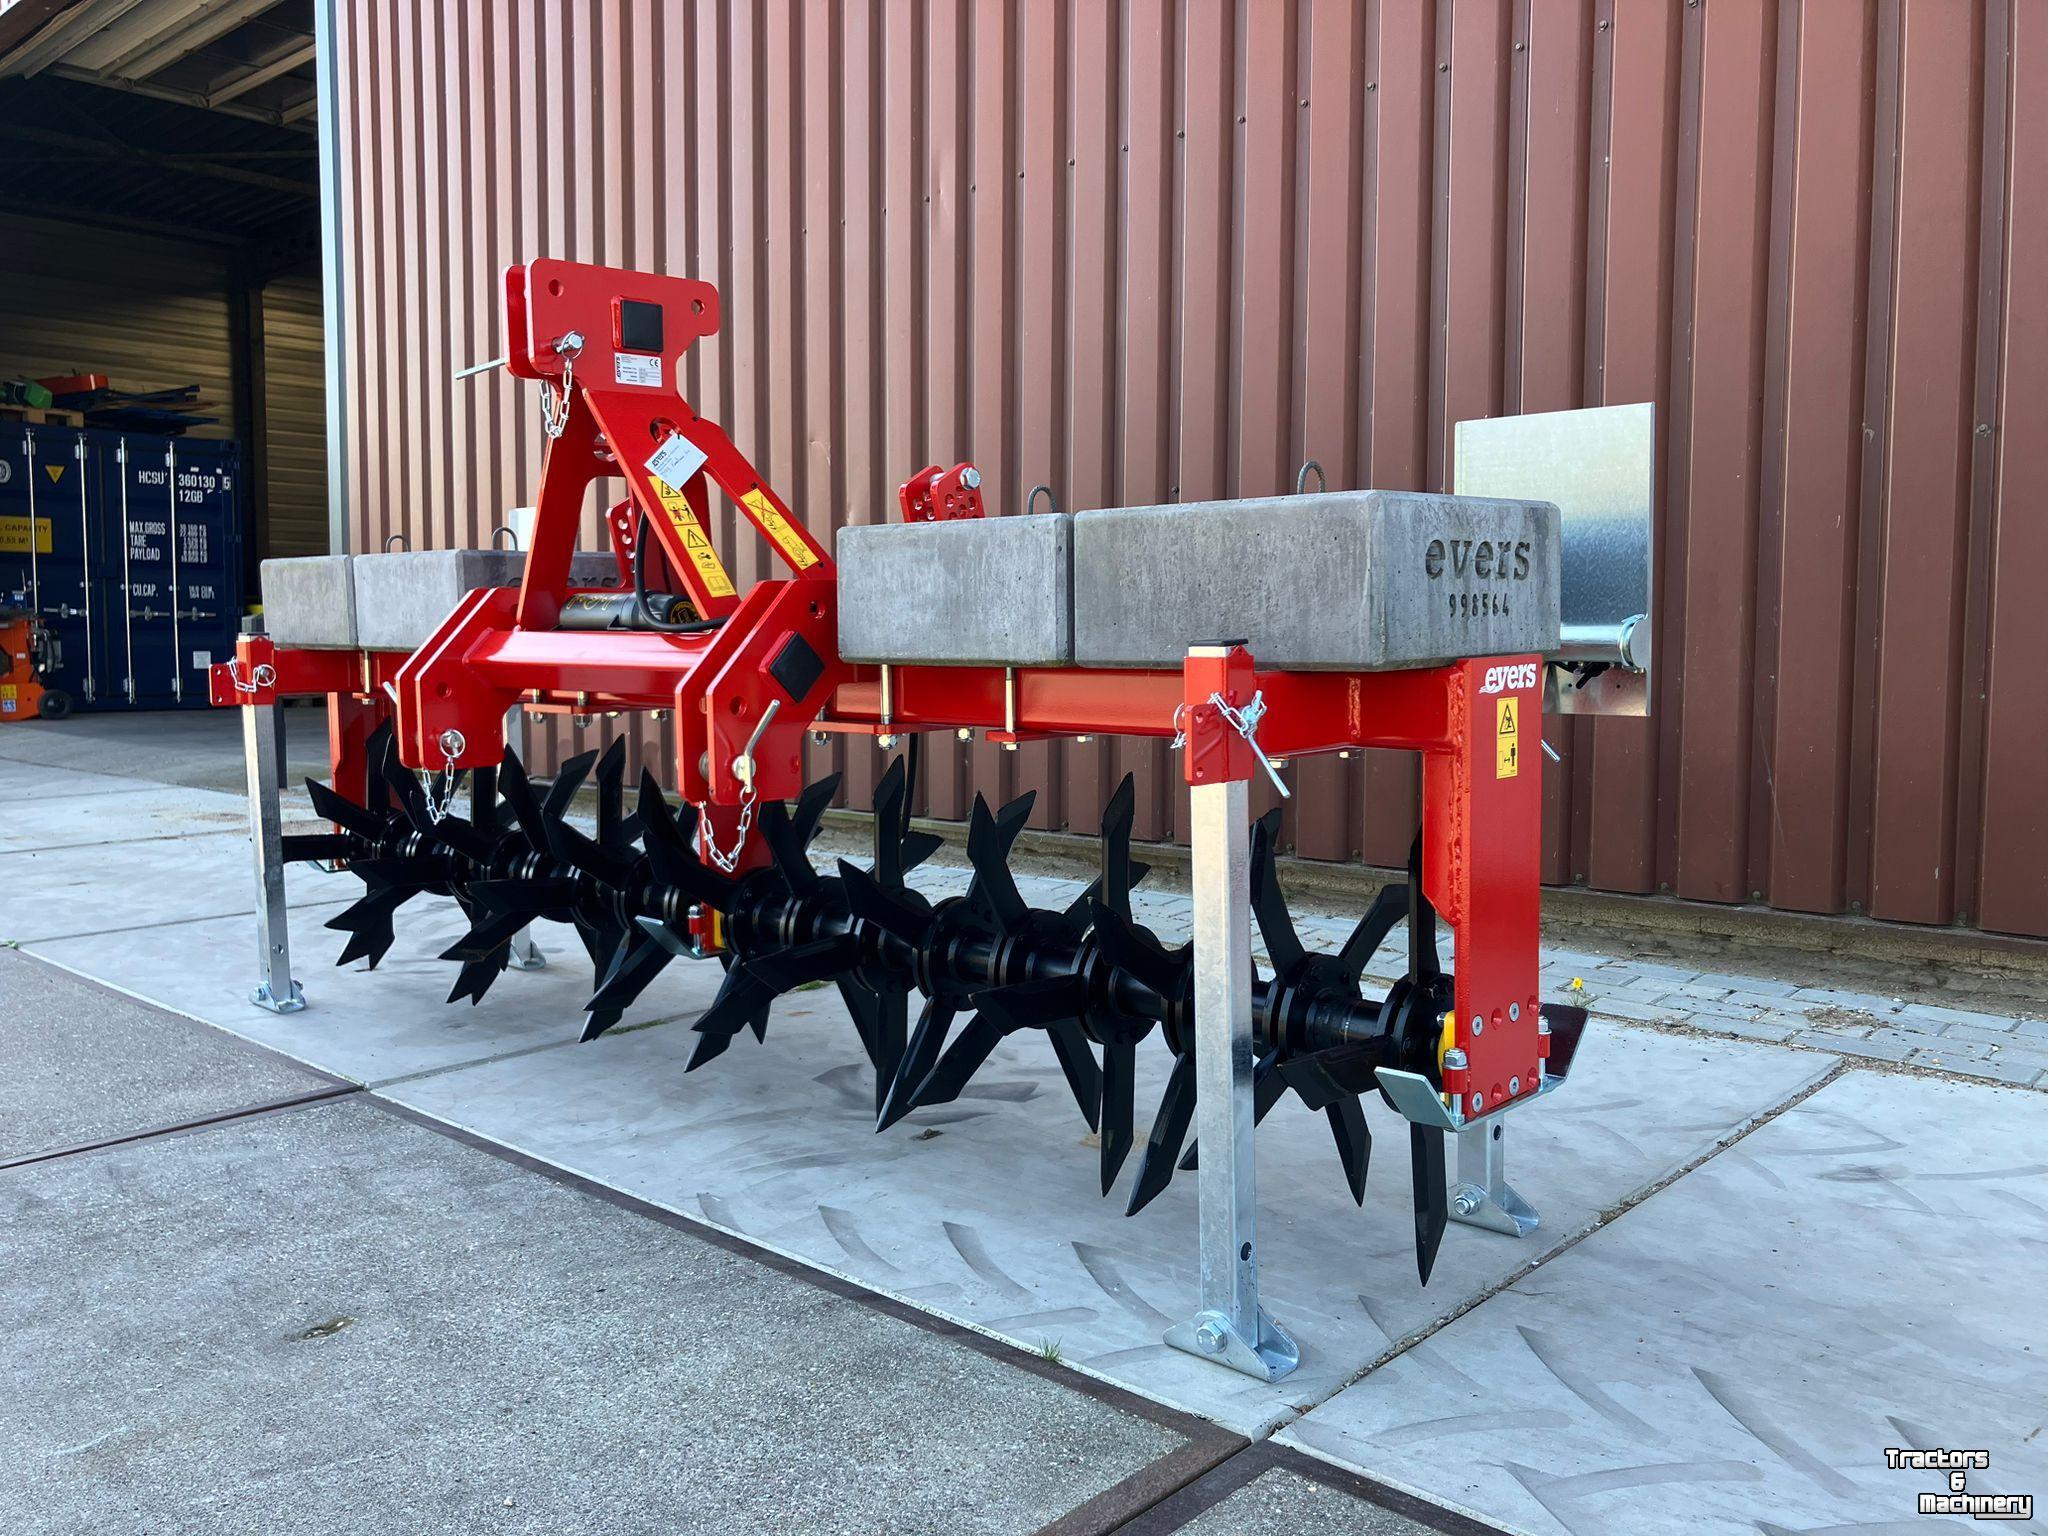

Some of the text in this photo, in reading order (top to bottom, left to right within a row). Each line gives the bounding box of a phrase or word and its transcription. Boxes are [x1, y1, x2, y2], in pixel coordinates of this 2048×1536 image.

[138, 470, 231, 490] HCSU 360130 5
[130, 534, 147, 547] TARE
[130, 547, 161, 561] PAYLOAD
[1425, 539, 1531, 581] evers
[1479, 664, 1537, 693] evers
